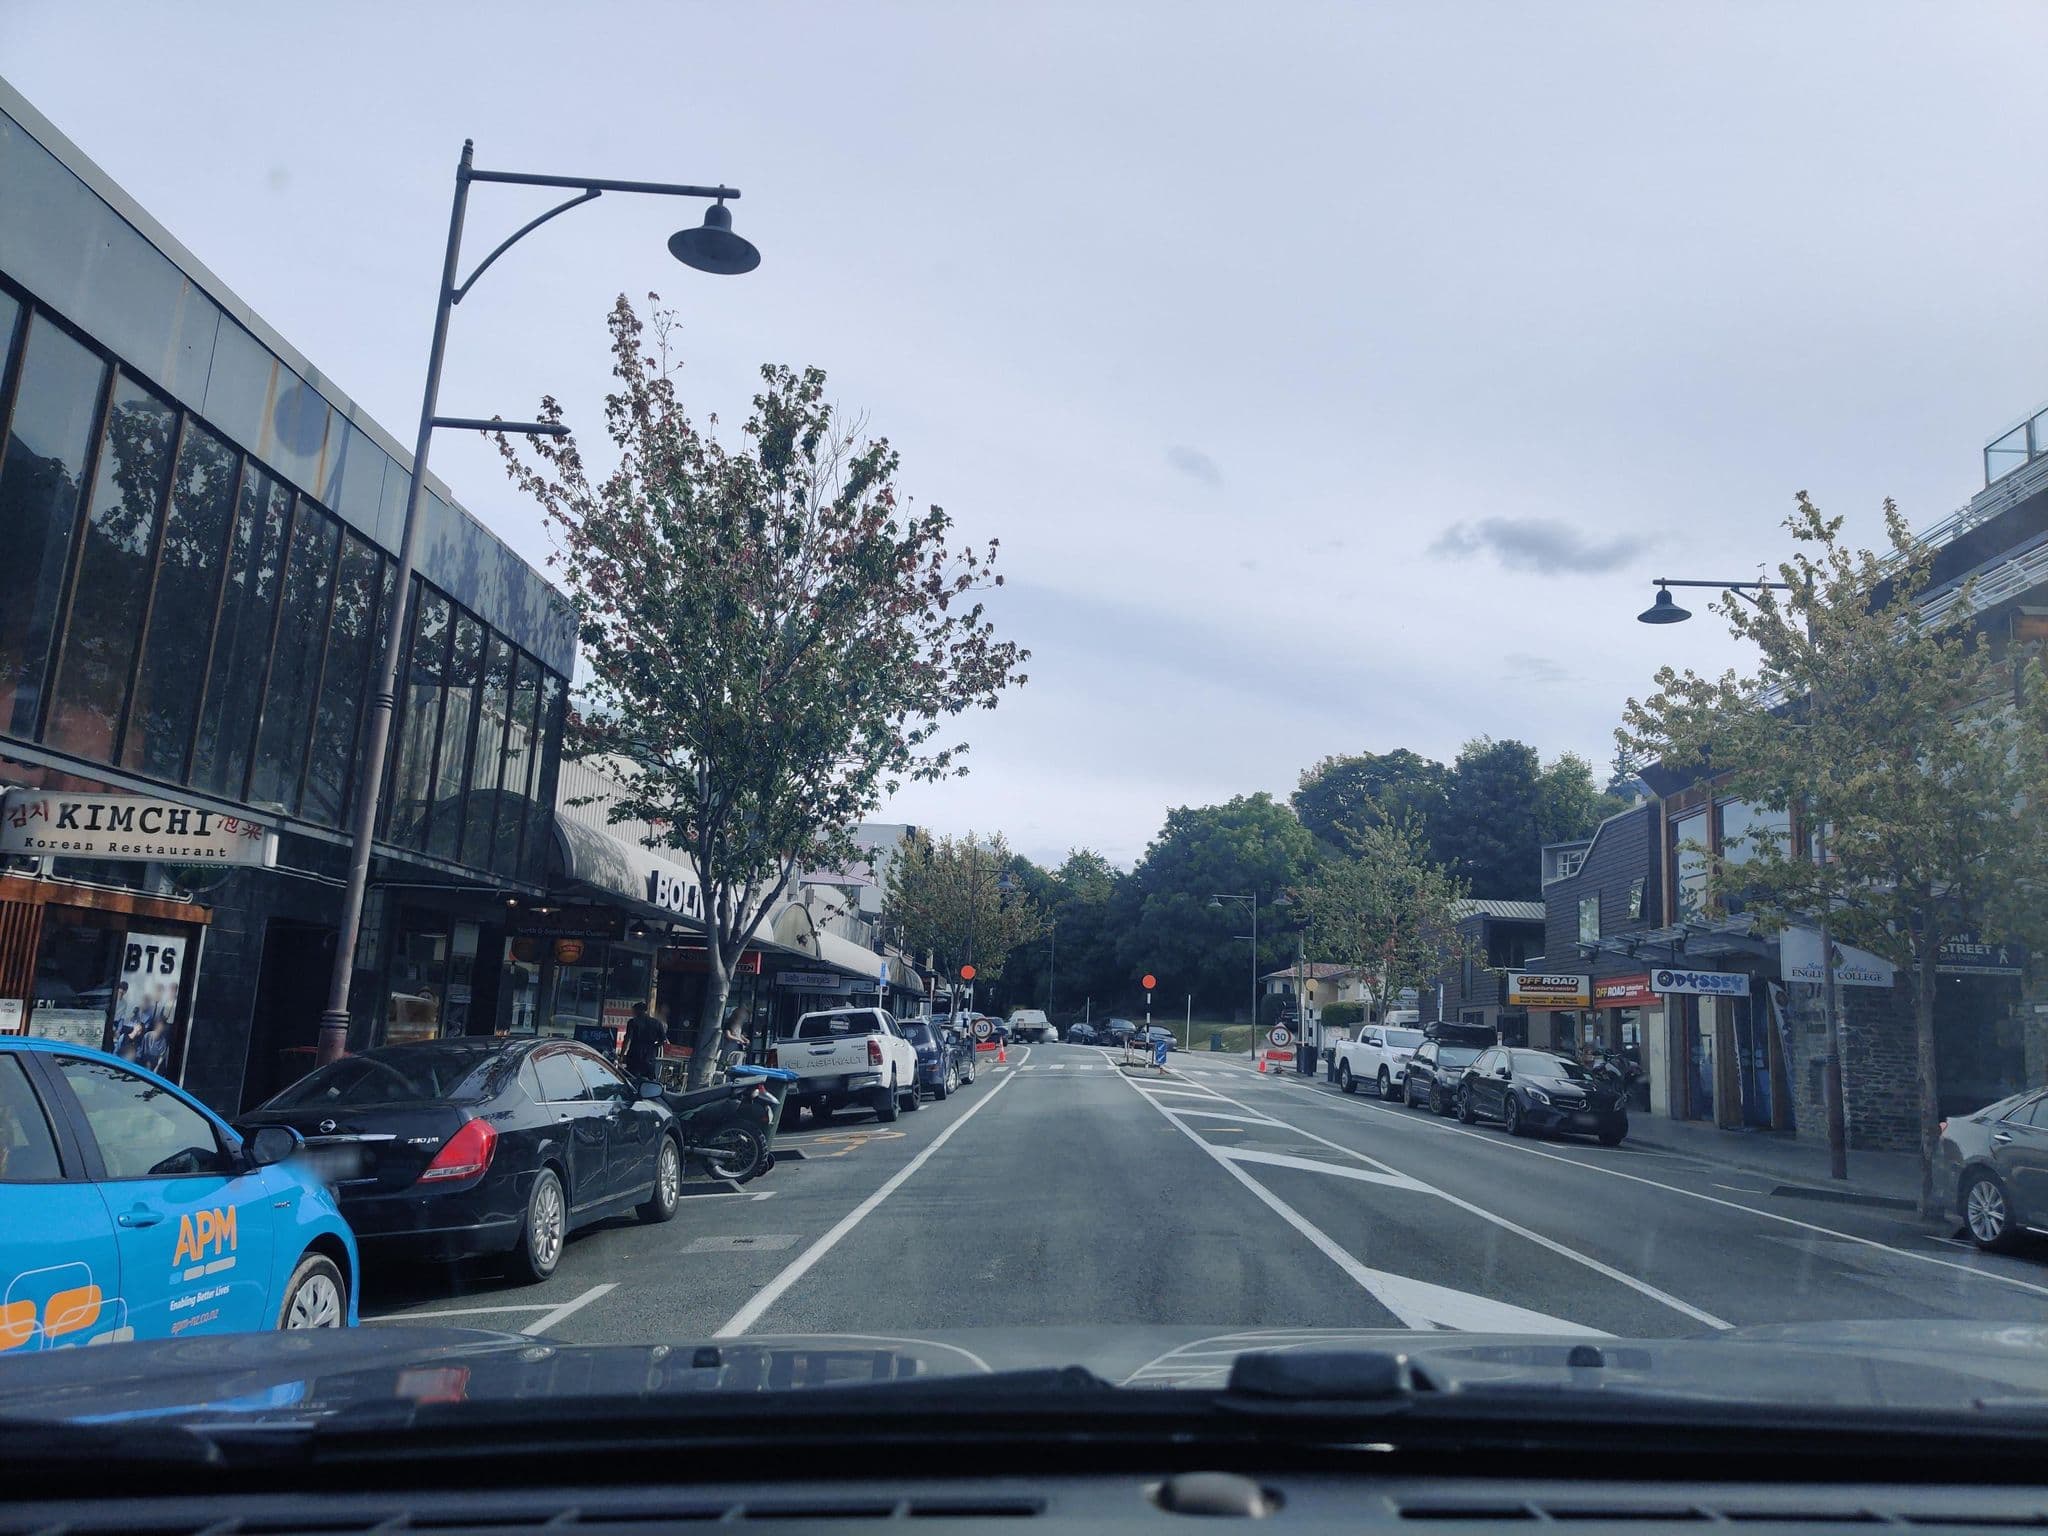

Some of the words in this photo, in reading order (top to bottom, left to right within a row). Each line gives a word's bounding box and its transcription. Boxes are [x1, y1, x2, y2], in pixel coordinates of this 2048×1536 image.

[56, 803, 213, 836] KIMCHI
[24, 836, 94, 851] Korean
[108, 841, 227, 858] Restaurant
[1939, 943, 1992, 955] STREET
[124, 943, 176, 975] BTS
[1517, 976, 1542, 985] OFF
[1542, 977, 1578, 986] ROAD
[1657, 970, 1744, 992] ODYSSEY
[1792, 969, 1824, 979] ENGLI
[1838, 971, 1882, 982] COLLEGE
[1596, 987, 1607, 998] OFF
[1607, 985, 1625, 997] ROAD
[976, 1024, 988, 1032] 30
[1274, 1033, 1286, 1041] 30
[806, 1056, 862, 1068] ASPHALT
[172, 1204, 237, 1266] APM
[170, 1295, 196, 1311] Enabling
[196, 1290, 216, 1303] Better
[215, 1285, 230, 1297] Lives
